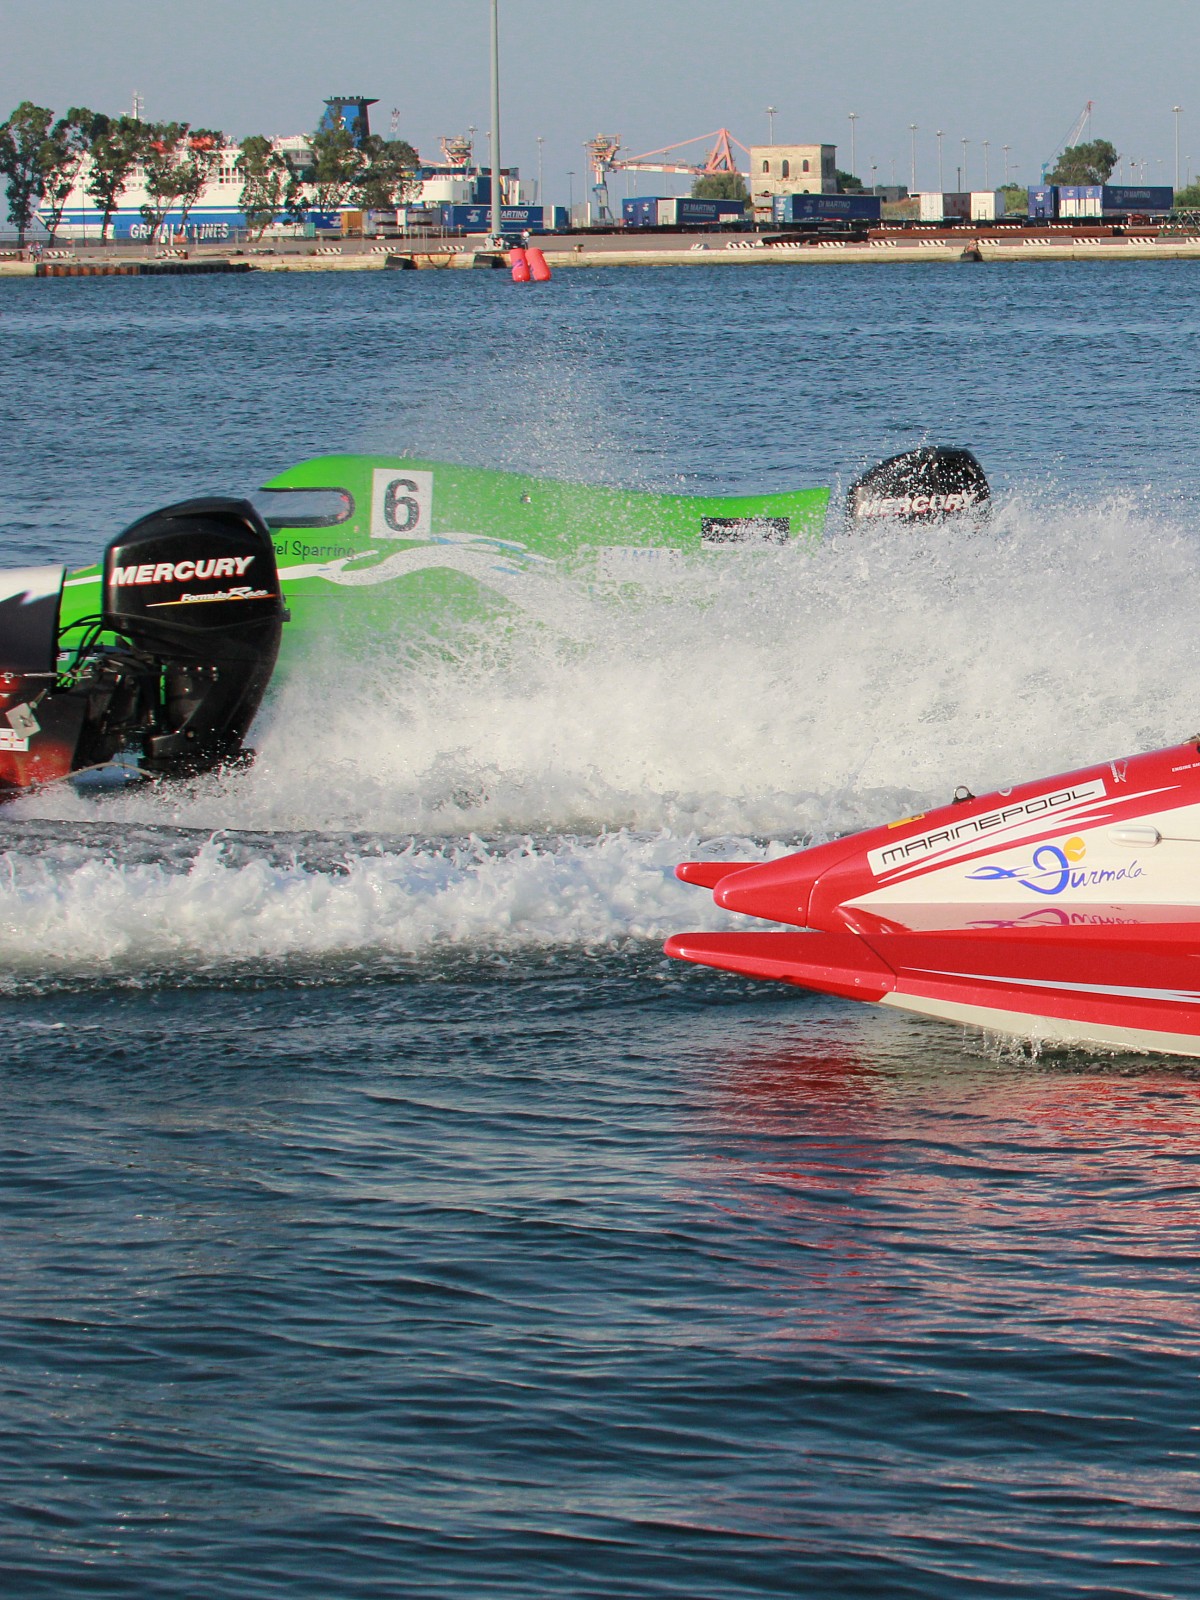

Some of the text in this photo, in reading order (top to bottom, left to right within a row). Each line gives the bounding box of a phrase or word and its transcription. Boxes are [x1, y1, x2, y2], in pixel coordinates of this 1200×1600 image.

[499, 210, 529, 218] ARTINO
[683, 203, 716, 212] DI MARTINO
[384, 479, 421, 532] 6
[858, 490, 979, 516] MERCURY
[272, 541, 355, 562] iel Sparring
[110, 555, 255, 586] MERCURY
[1171, 764, 1192, 772] ENGINE
[881, 789, 1095, 864] MARINEPOOL
